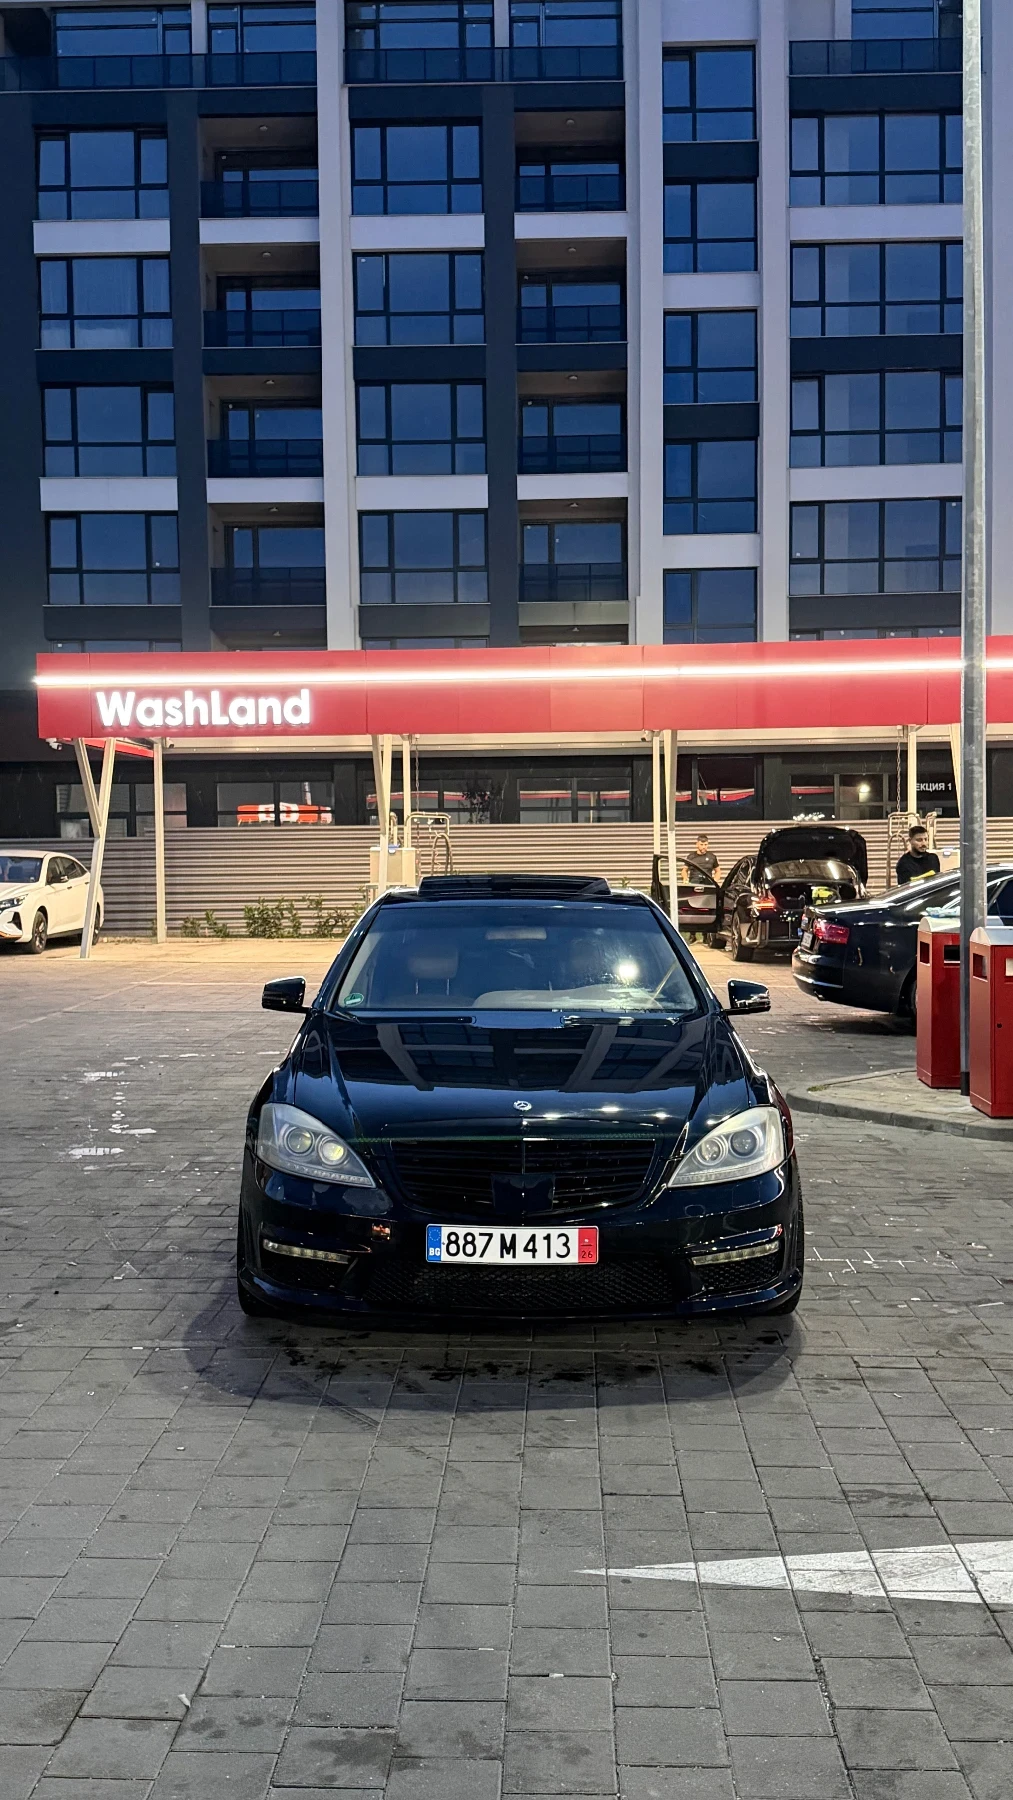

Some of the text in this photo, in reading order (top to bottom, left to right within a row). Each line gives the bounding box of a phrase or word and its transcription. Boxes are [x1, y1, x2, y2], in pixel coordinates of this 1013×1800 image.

[97, 689, 310, 727] WashLand
[916, 782, 945, 792] ЕКЦИЯ
[445, 1231, 494, 1258] 887
[523, 1233, 571, 1259] 413
[429, 1247, 441, 1256] BG
[581, 1250, 593, 1259] 26
